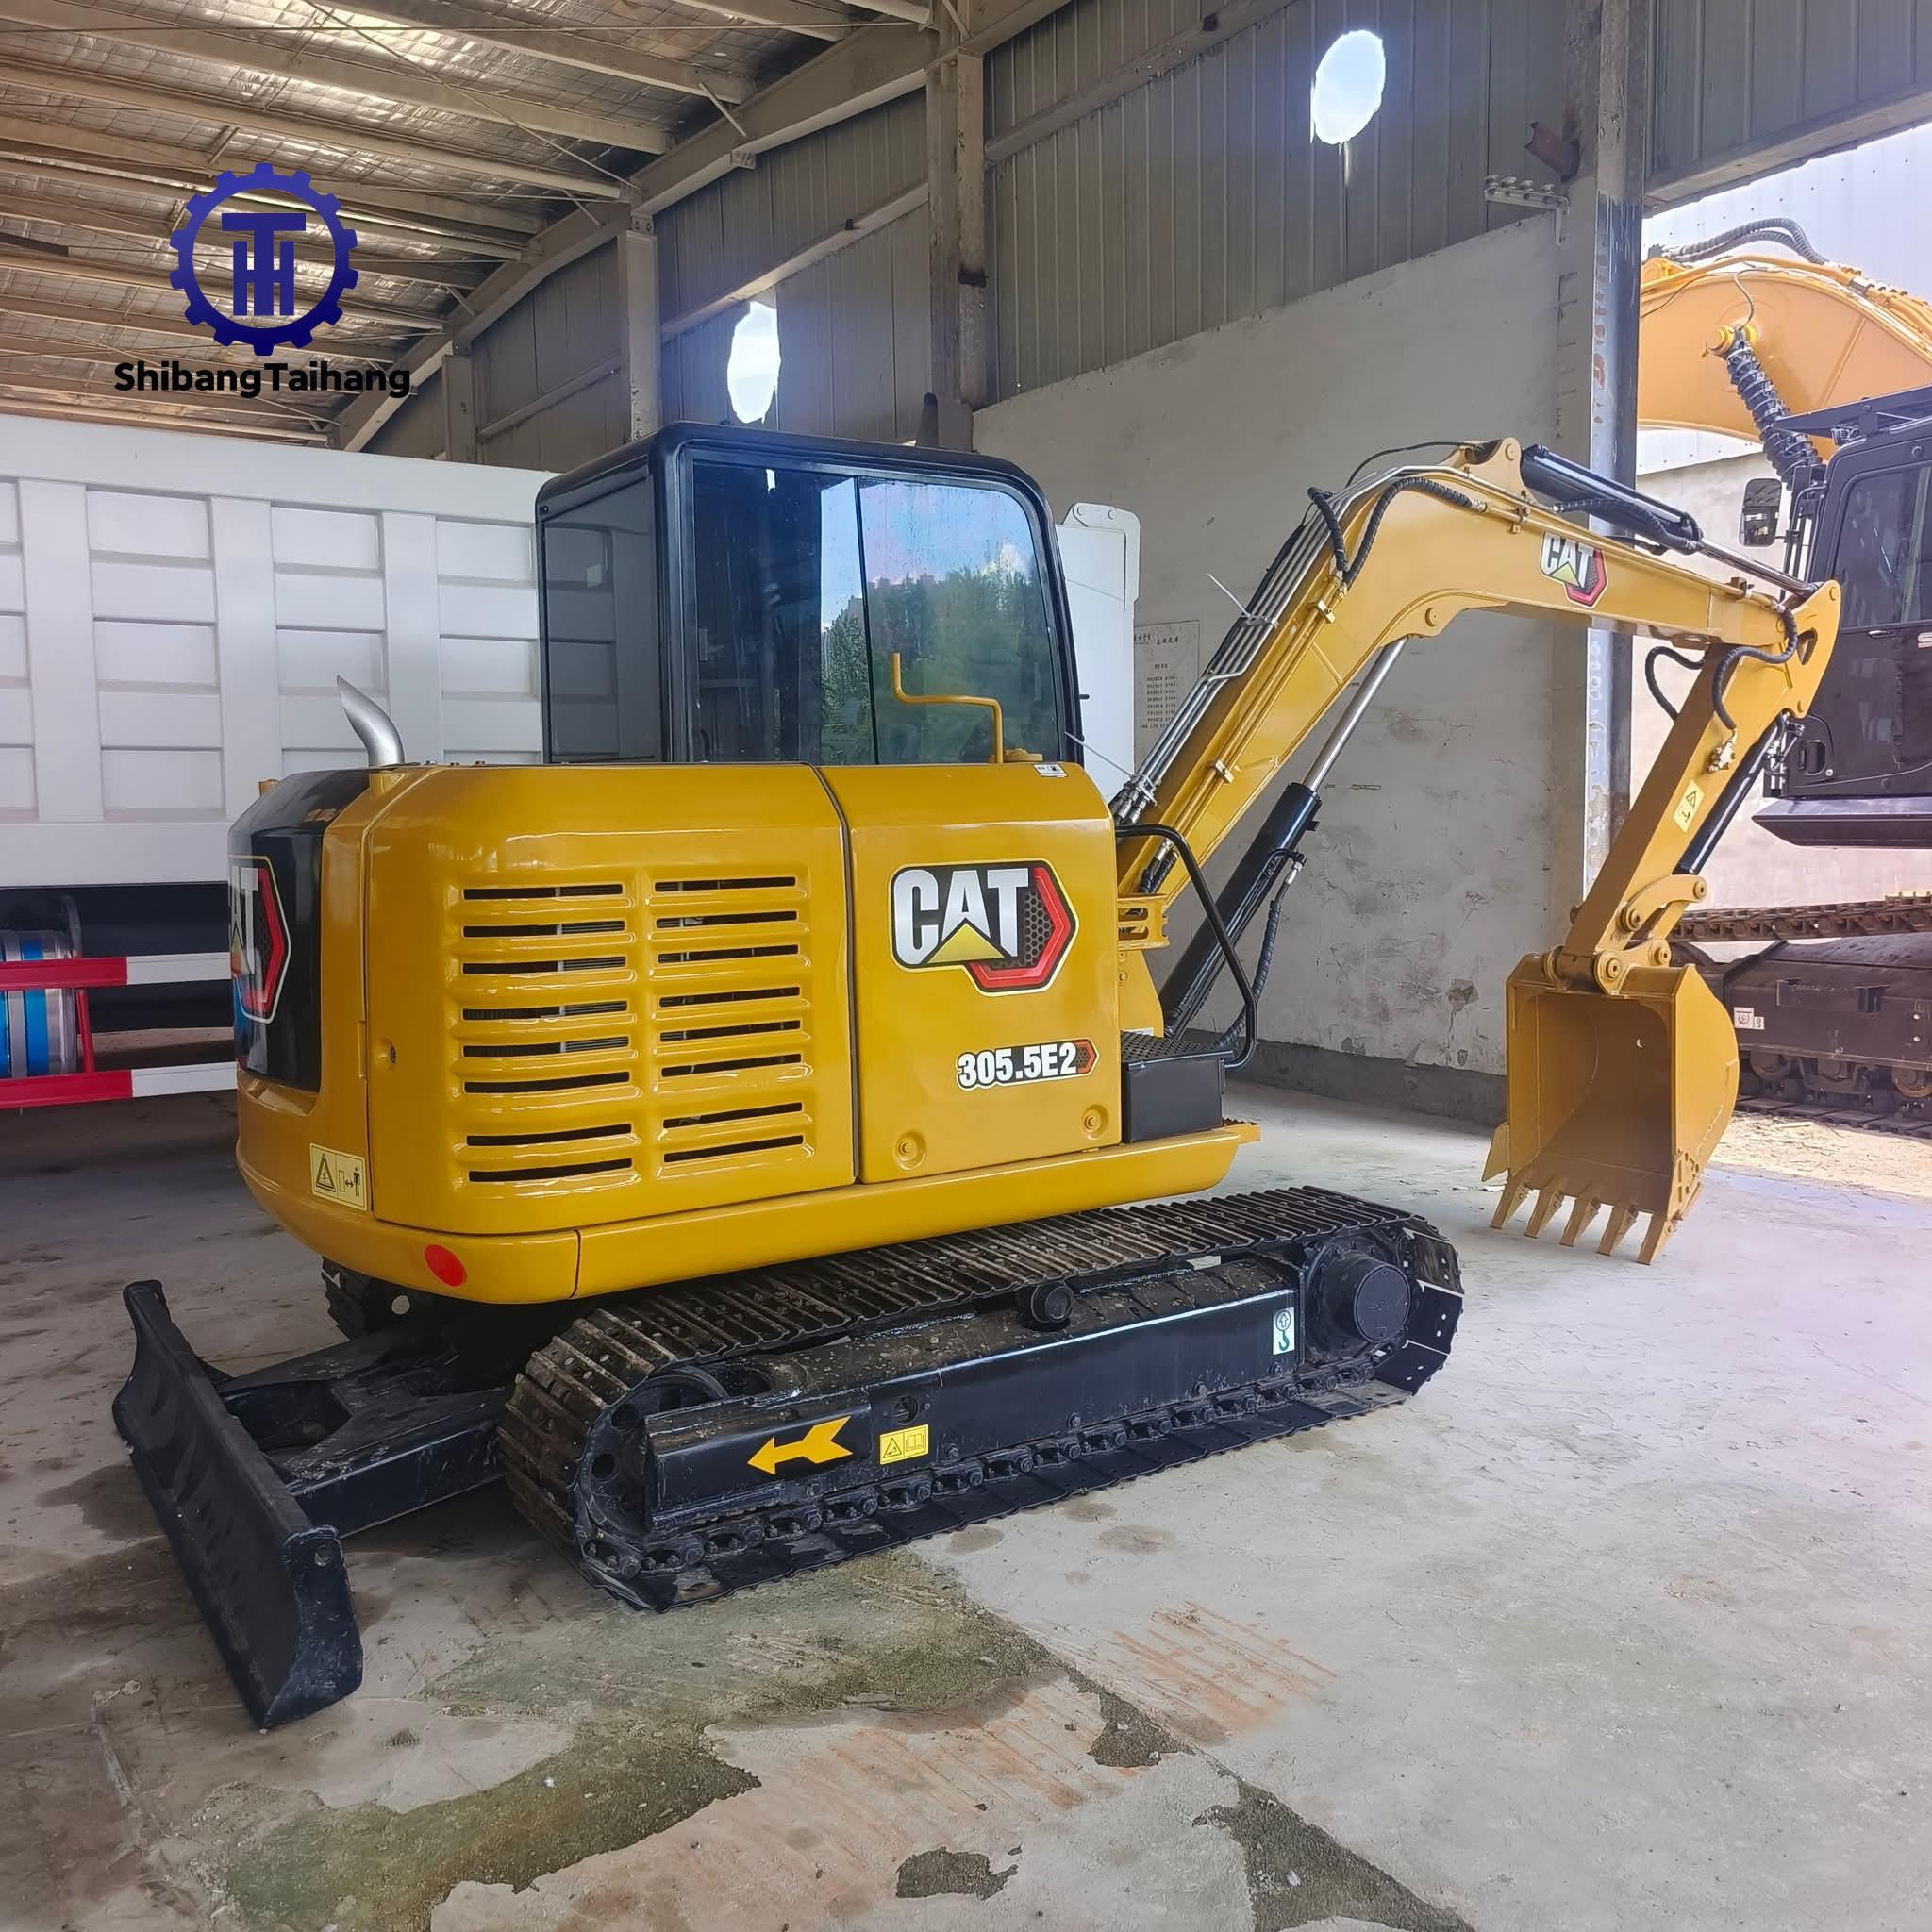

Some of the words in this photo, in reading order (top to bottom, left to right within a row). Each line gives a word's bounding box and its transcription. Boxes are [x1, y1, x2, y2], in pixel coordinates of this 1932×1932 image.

[1541, 531, 1594, 588] CAT
[228, 866, 258, 974] AT
[893, 868, 1029, 964] CAT
[958, 1042, 1077, 1085] 305.5E2
